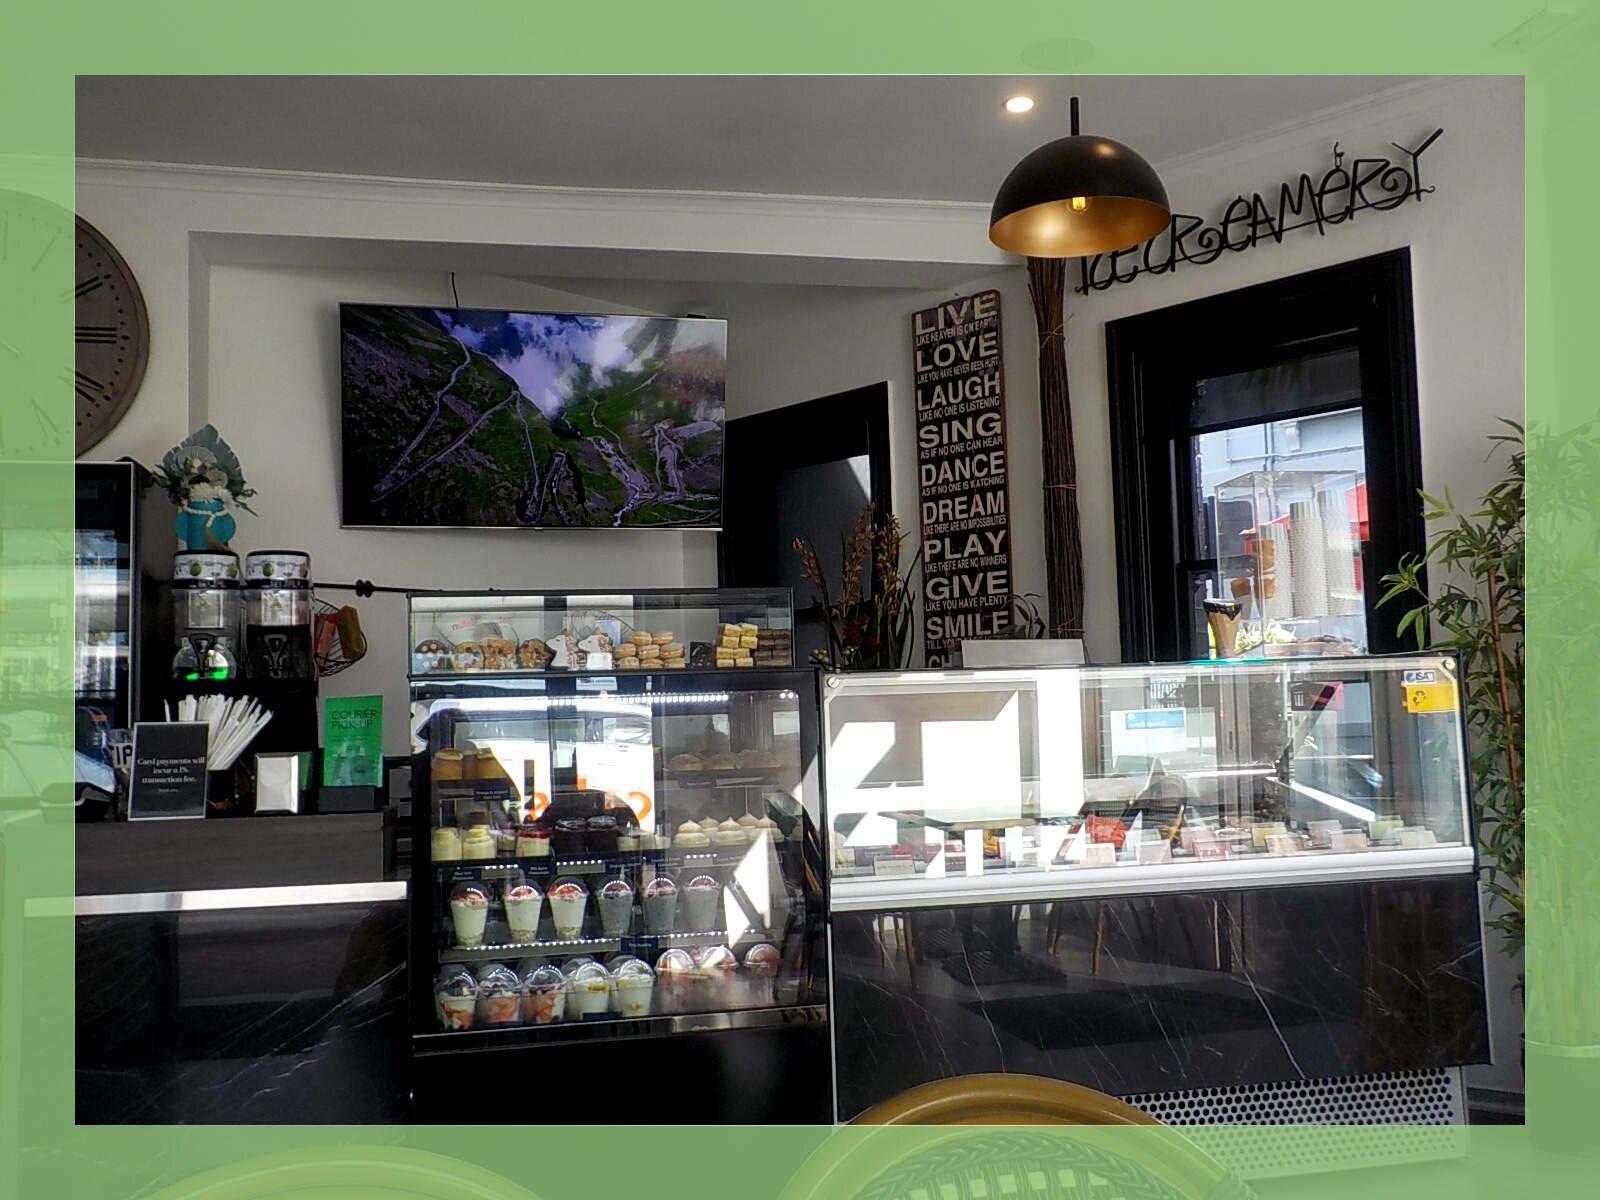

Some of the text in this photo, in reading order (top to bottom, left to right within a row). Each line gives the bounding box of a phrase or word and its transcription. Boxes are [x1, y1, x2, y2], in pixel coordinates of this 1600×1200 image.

[916, 294, 997, 335] LIVE
[916, 334, 930, 347] LIKE
[931, 328, 955, 342] HEAVEN
[957, 326, 963, 335] IS
[917, 332, 998, 373] LOVE
[918, 356, 999, 384] LIKE YOU HAVE NEVER BEEN HURT
[917, 372, 1000, 411] LAUGH
[919, 396, 999, 422] LIKE NO ONE IS LISTENING
[919, 412, 1001, 448] SING
[921, 435, 1003, 459] AS IF NO ONE CAN HEAR
[921, 451, 1005, 487] DANCE
[922, 475, 1004, 496] AS IF NO ONE IS WATCHING
[922, 490, 1005, 525] DREAM
[924, 524, 934, 536] LIKE
[934, 522, 950, 534] THERE
[950, 520, 960, 531] ARE
[960, 520, 967, 530] NO
[924, 529, 1006, 563] PLAY
[925, 554, 1007, 573] LIKE THERE ARE NO WINNERS
[926, 570, 1008, 600] GIVE
[925, 595, 1008, 612] LIKE YOU HAVE PLENTY
[926, 611, 1008, 640] SMILE
[927, 640, 943, 650] TILL
[332, 709, 378, 721] COURIER
[156, 758, 191, 767] payments
[191, 756, 205, 765] will
[142, 776, 183, 784] transaction
